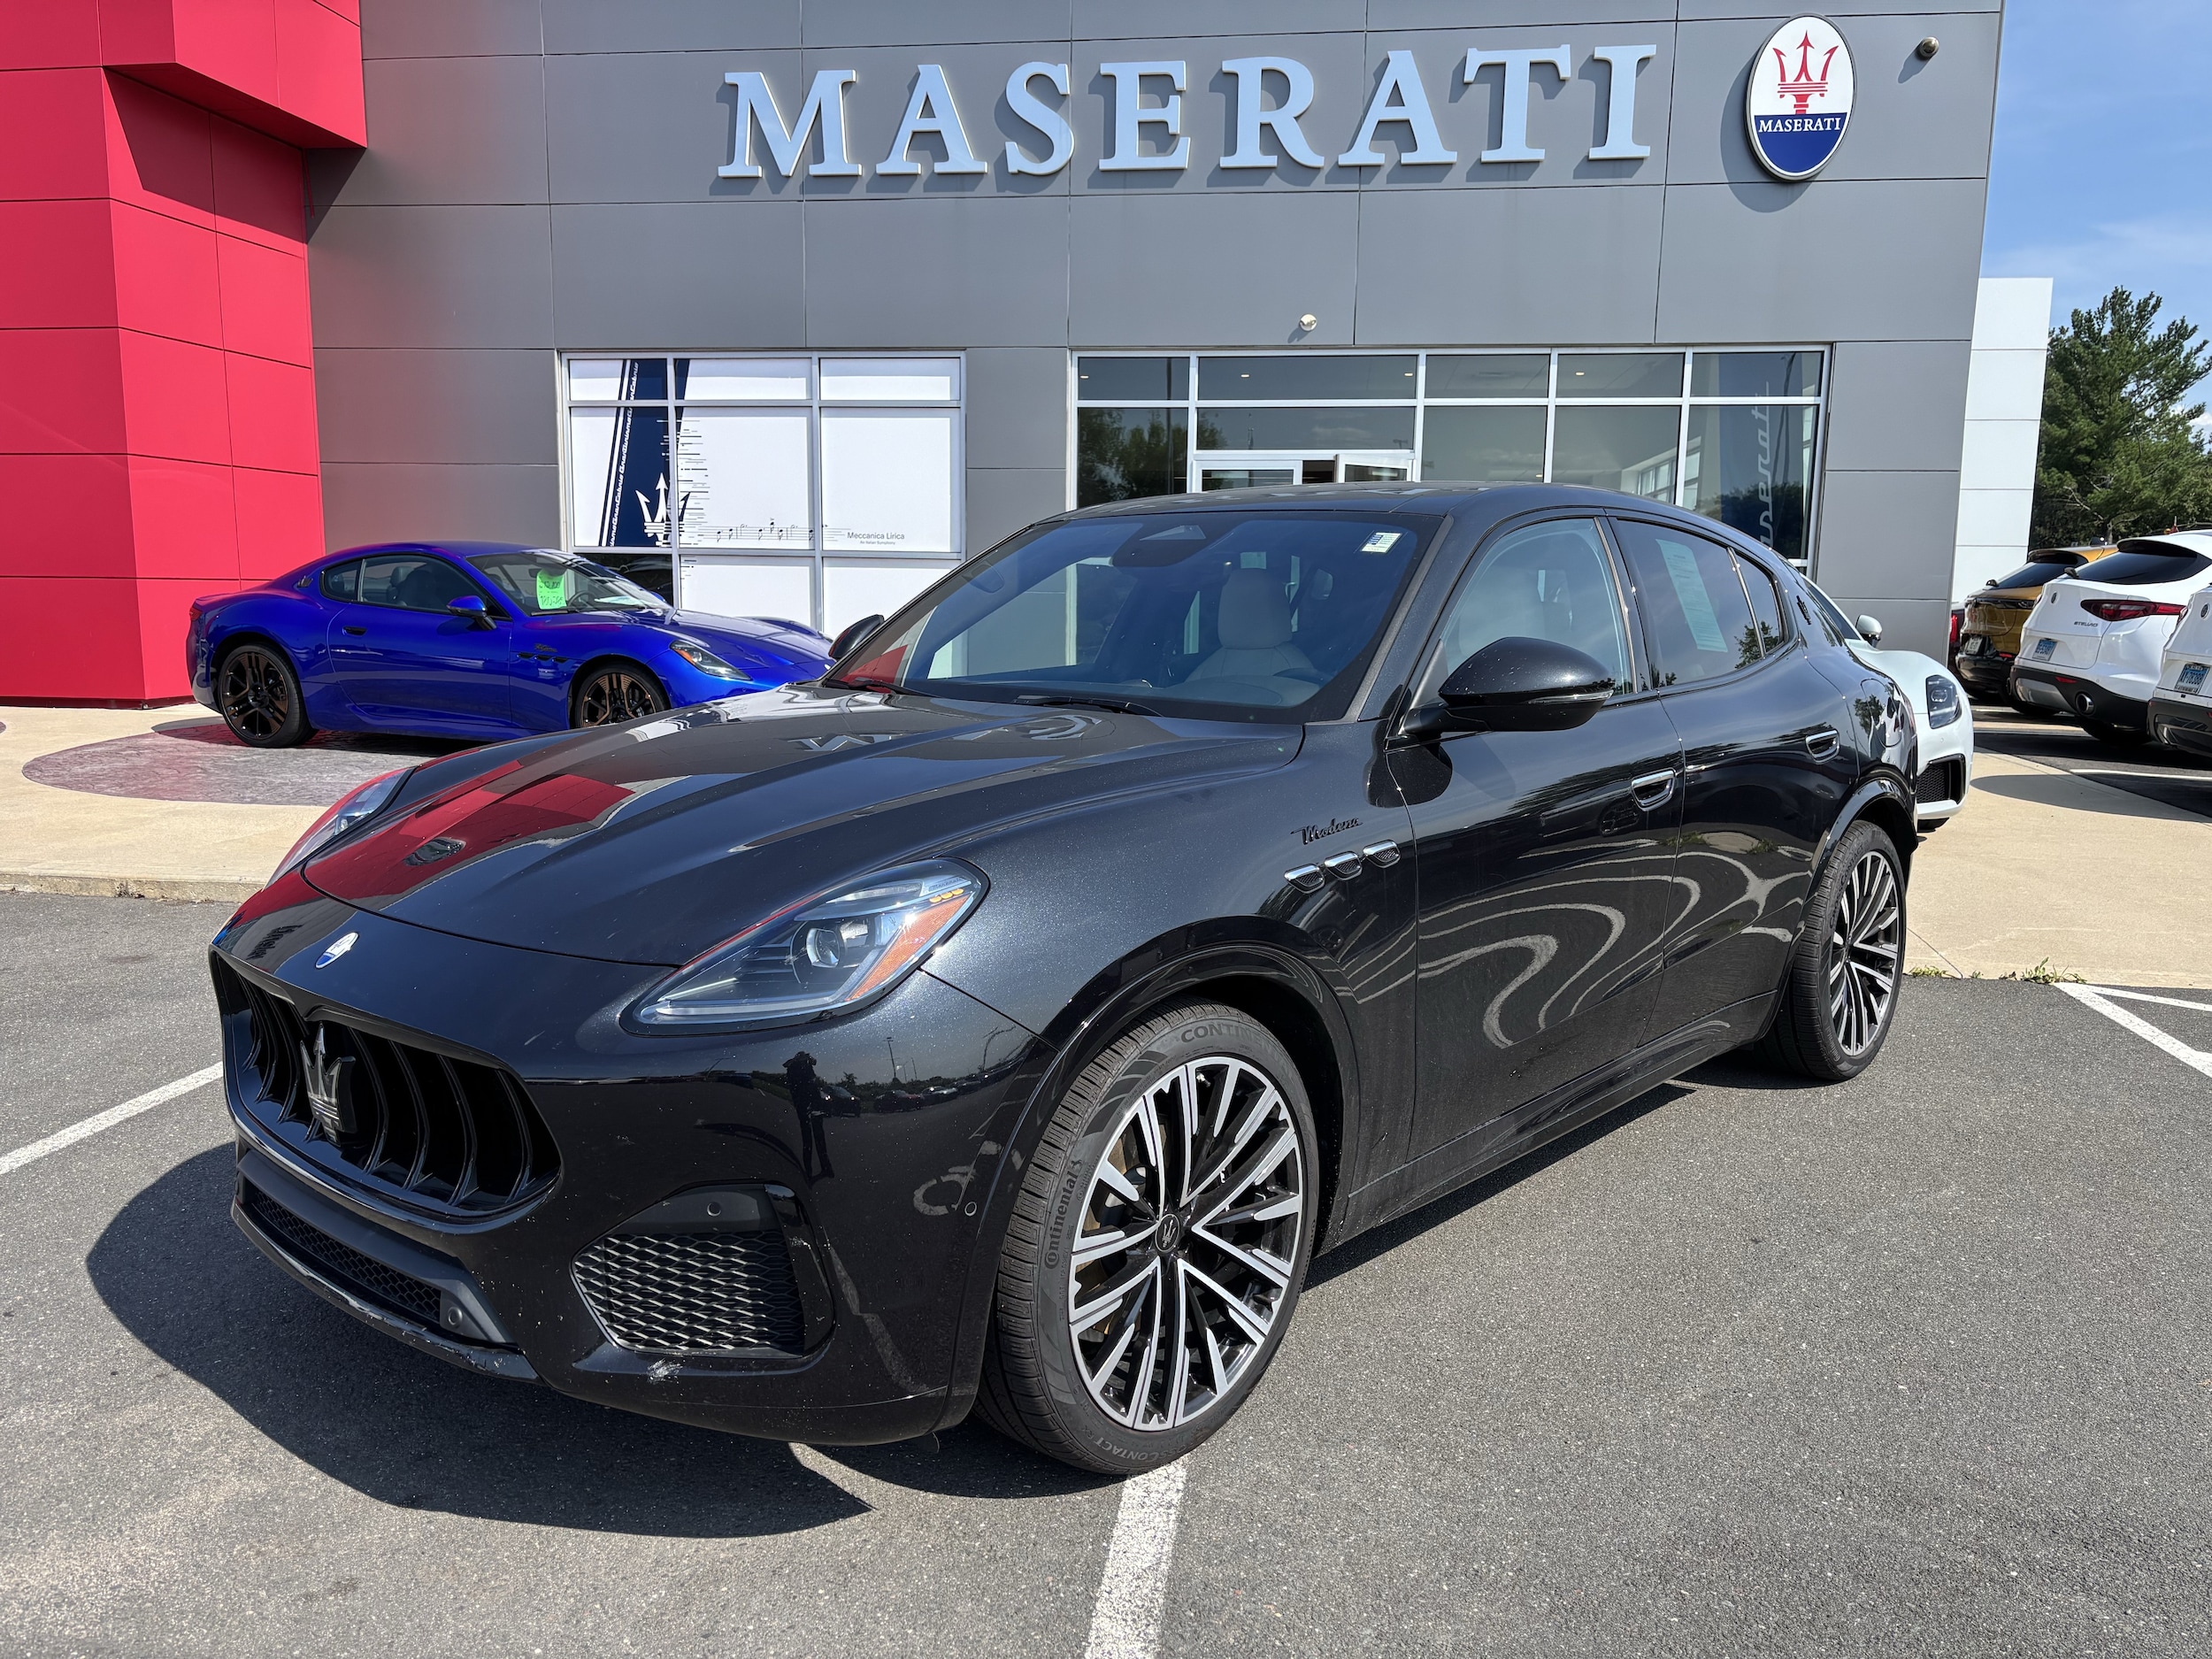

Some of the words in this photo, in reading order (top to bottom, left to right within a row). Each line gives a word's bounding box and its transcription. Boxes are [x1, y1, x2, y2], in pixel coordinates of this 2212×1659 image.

[718, 43, 1657, 177] MASERATI
[1758, 117, 1841, 133] MASERATI
[1290, 818, 1363, 846] Modena
[1044, 1171, 1079, 1270] Continental
